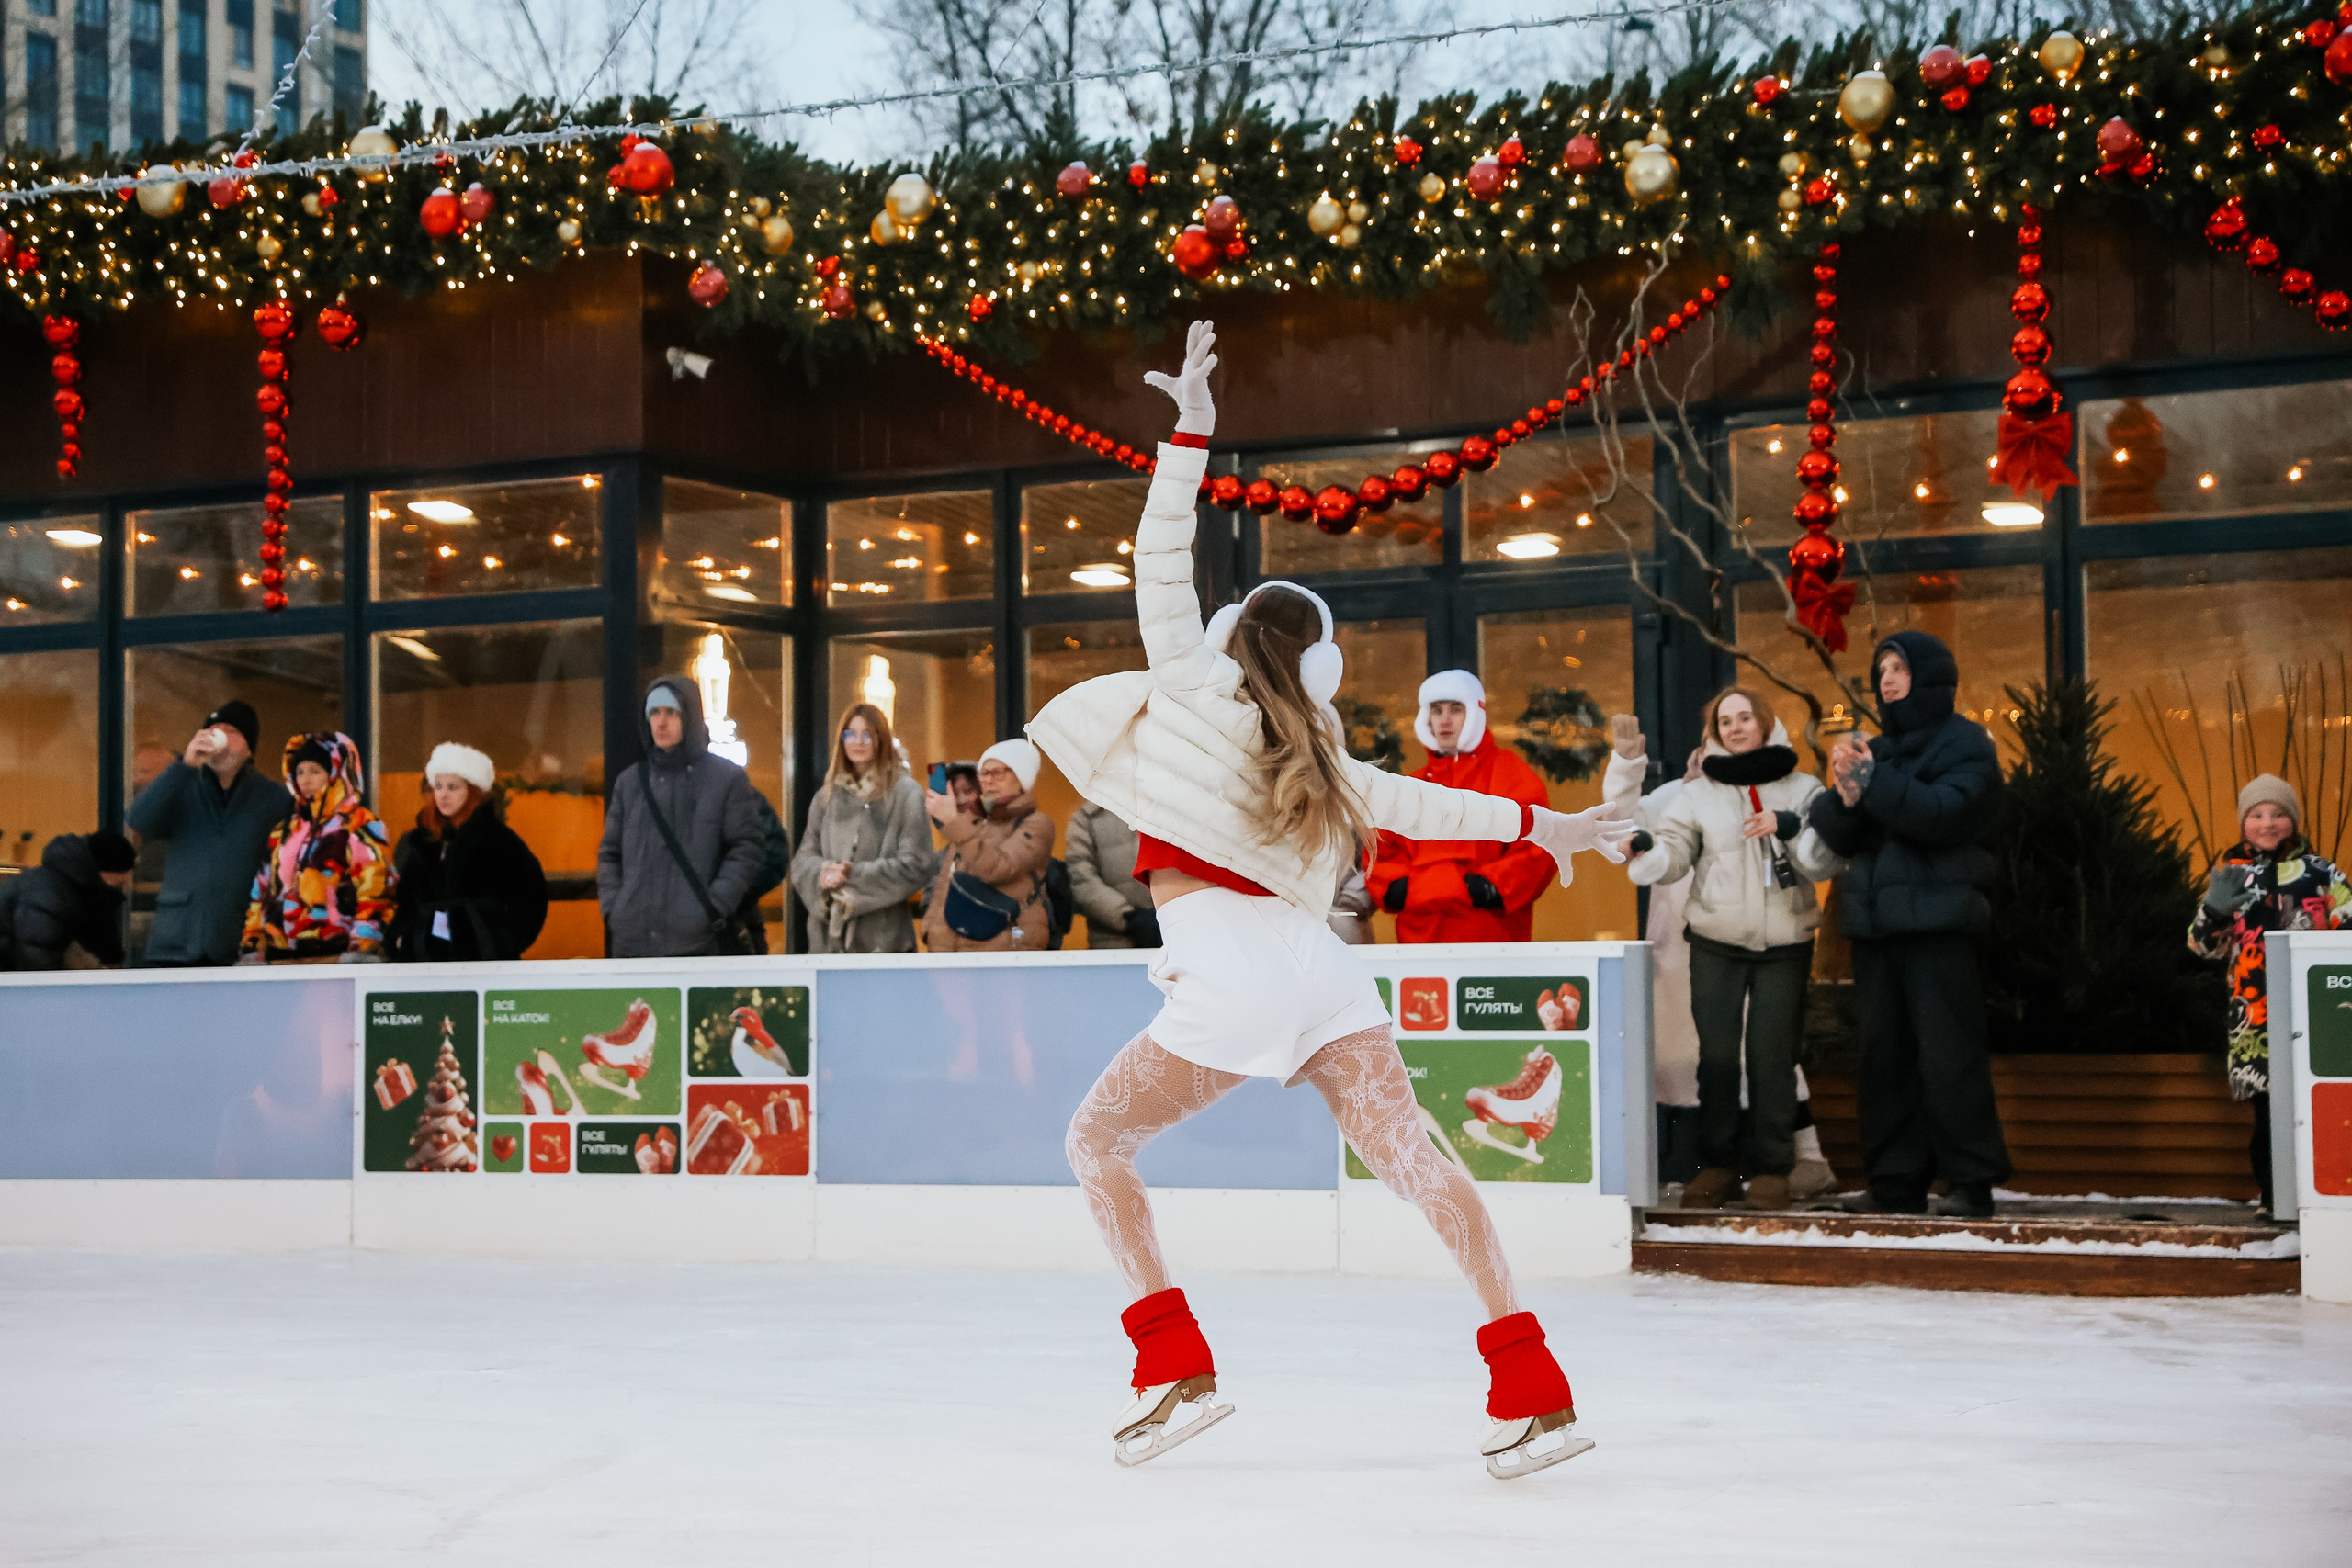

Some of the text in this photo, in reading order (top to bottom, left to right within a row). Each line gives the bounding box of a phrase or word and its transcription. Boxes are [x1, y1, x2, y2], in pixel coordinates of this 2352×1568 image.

[2326, 975, 2352, 989] ВС
[1465, 987, 1495, 999] ВСЕ
[372, 1001, 395, 1013] ВСЕ
[492, 999, 515, 1011] ВСЕ
[372, 1015, 389, 1026] НА
[492, 1013, 510, 1023] НА
[582, 1130, 605, 1142] ВСЕ
